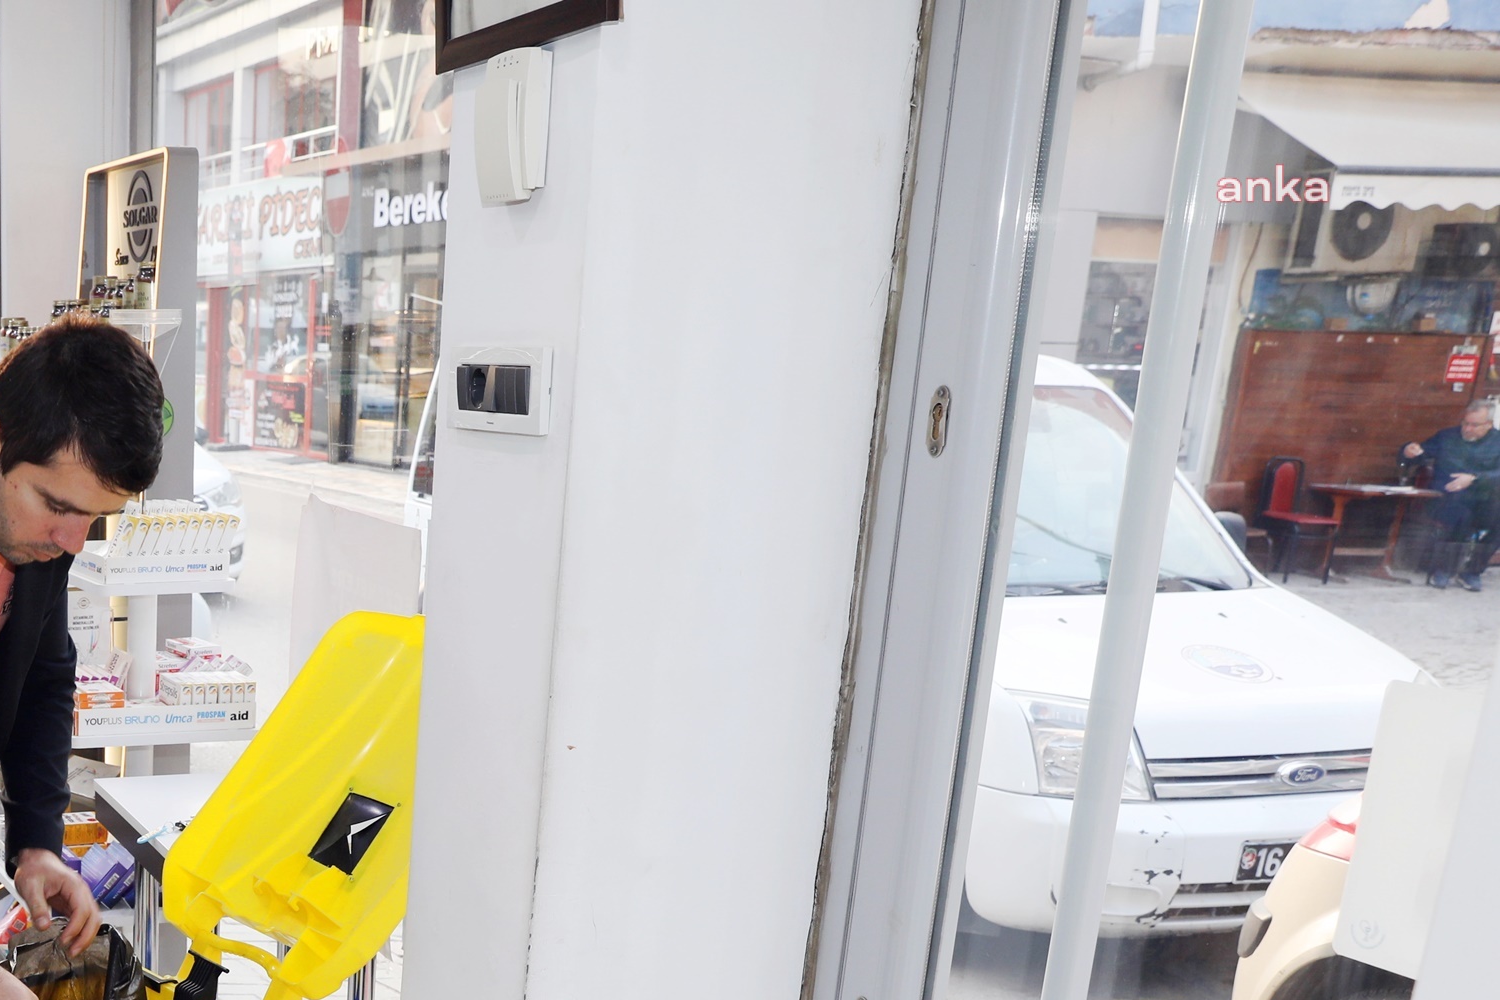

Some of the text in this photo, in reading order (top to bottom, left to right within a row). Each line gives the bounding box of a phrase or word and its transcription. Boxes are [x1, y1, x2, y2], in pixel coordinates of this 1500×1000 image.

[122, 205, 158, 228] SOLGAR
[259, 186, 321, 240] PİDEC
[165, 565, 185, 573] Umca
[165, 713, 193, 724] Umca
[197, 711, 226, 719] PROSPAN
[230, 711, 249, 721] aid
[1294, 767, 1318, 783] Ford
[1256, 847, 1284, 878] 16
